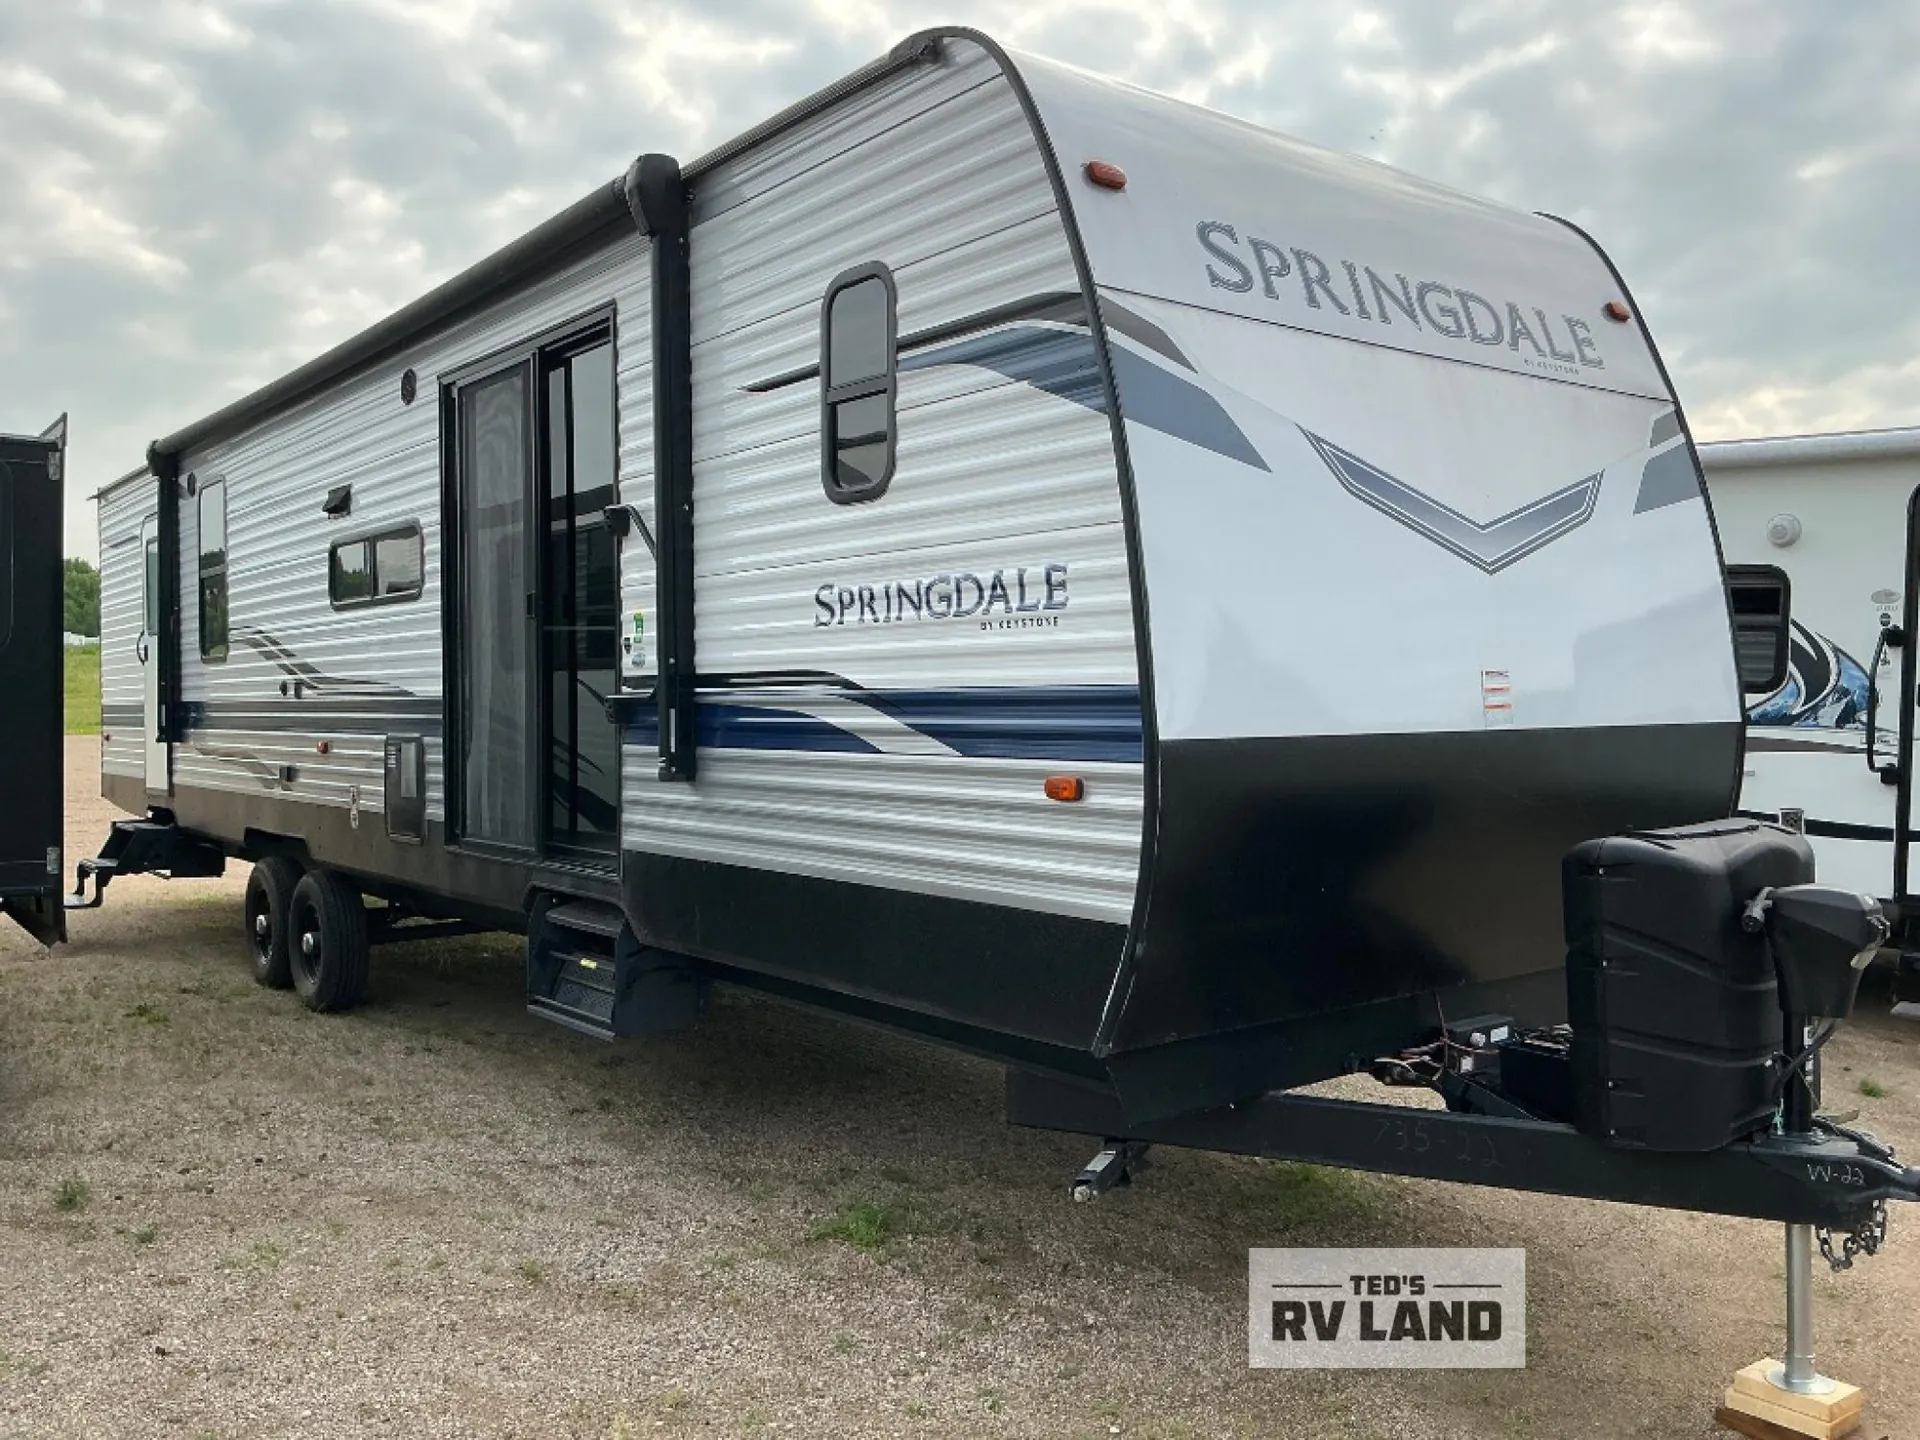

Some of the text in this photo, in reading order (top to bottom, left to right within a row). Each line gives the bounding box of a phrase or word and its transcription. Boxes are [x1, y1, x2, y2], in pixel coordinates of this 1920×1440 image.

[1196, 220, 1604, 369] SPRINGDALE
[814, 563, 1070, 627] SPRINGDALE
[998, 616, 1059, 629] KEYSTONE
